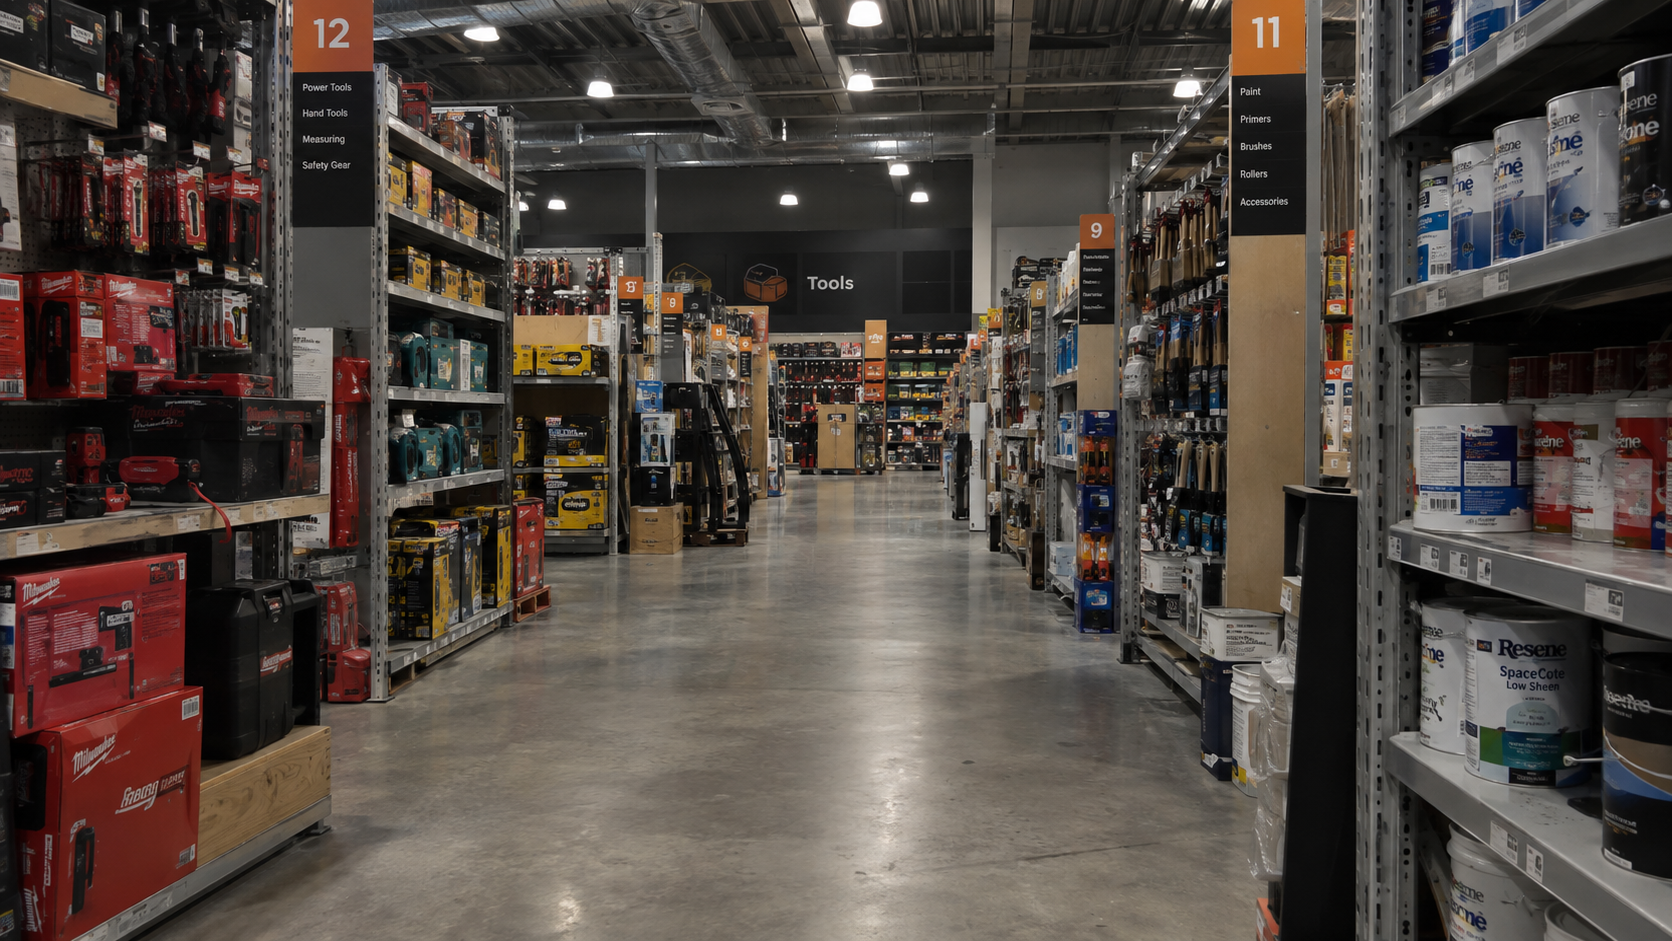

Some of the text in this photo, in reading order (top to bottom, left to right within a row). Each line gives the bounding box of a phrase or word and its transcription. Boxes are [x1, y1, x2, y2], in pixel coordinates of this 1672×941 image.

[313, 18, 350, 49] 12
[1251, 16, 1280, 48] 11
[302, 83, 352, 92] Power Tools
[1240, 87, 1261, 96] Paint
[302, 109, 348, 118] Hand Tools
[1240, 115, 1271, 124] Primers
[302, 135, 345, 145] Measuring
[1240, 142, 1272, 151] Brushes
[302, 161, 351, 172] Safety Gear
[1240, 170, 1268, 179] Rollers
[1240, 197, 1289, 207] Accessories
[1090, 222, 1103, 239] 9
[807, 275, 854, 290] Tools
[1497, 639, 1567, 660] Resene
[1499, 666, 1565, 680] SpaceCote
[1506, 681, 1560, 692] Low Sheen
